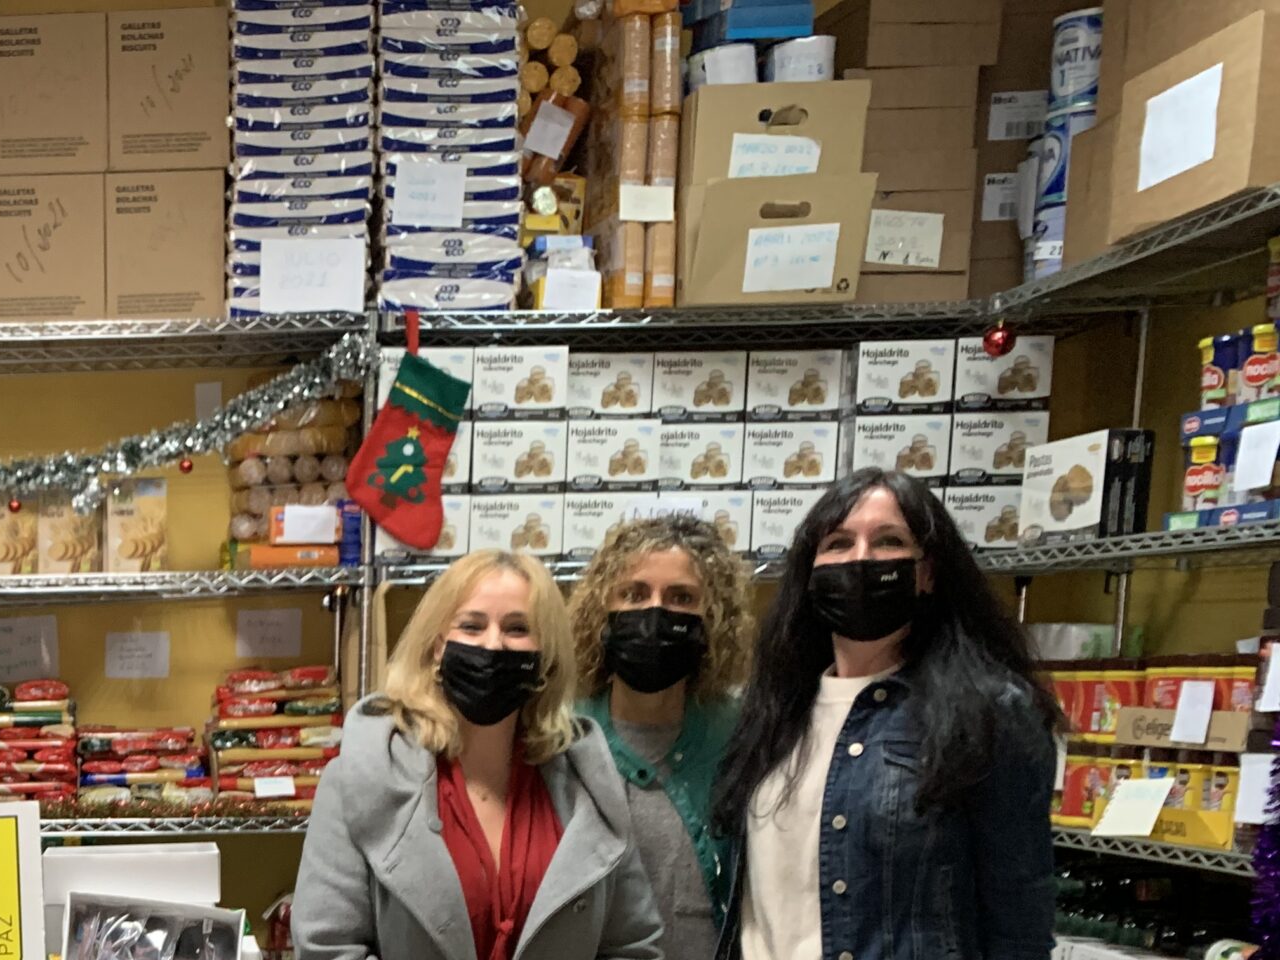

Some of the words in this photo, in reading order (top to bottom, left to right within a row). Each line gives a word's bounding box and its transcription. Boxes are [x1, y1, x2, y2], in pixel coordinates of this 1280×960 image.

[0, 27, 38, 36] GALLETAS
[121, 22, 161, 31] GALLETAS
[121, 32, 164, 41] BOLACHAS
[0, 38, 41, 47] BOLACHAS
[121, 44, 157, 52] BISCUITS
[0, 49, 35, 58] BISCUITS
[116, 185, 155, 193] GALLETAS
[116, 195, 158, 204] BOLACHAS
[116, 206, 151, 214] BISCUITS
[476, 354, 524, 365] Hojaldrito
[862, 349, 909, 360] Hojaldrito
[657, 358, 703, 369] Hojaldrito
[751, 358, 798, 368] Hojaldrito
[858, 422, 906, 434] Hojaldrito
[956, 419, 1004, 431] Hojaldrito
[476, 429, 523, 440] Hojaldrito
[571, 427, 617, 439] Hojaldrito
[747, 430, 793, 441] Hojaldrito
[756, 497, 803, 508] Hojaldrito
[947, 493, 995, 505] Hojaldrito
[473, 501, 520, 512] Hojaldrito
[567, 500, 613, 511] Hojaldrito
